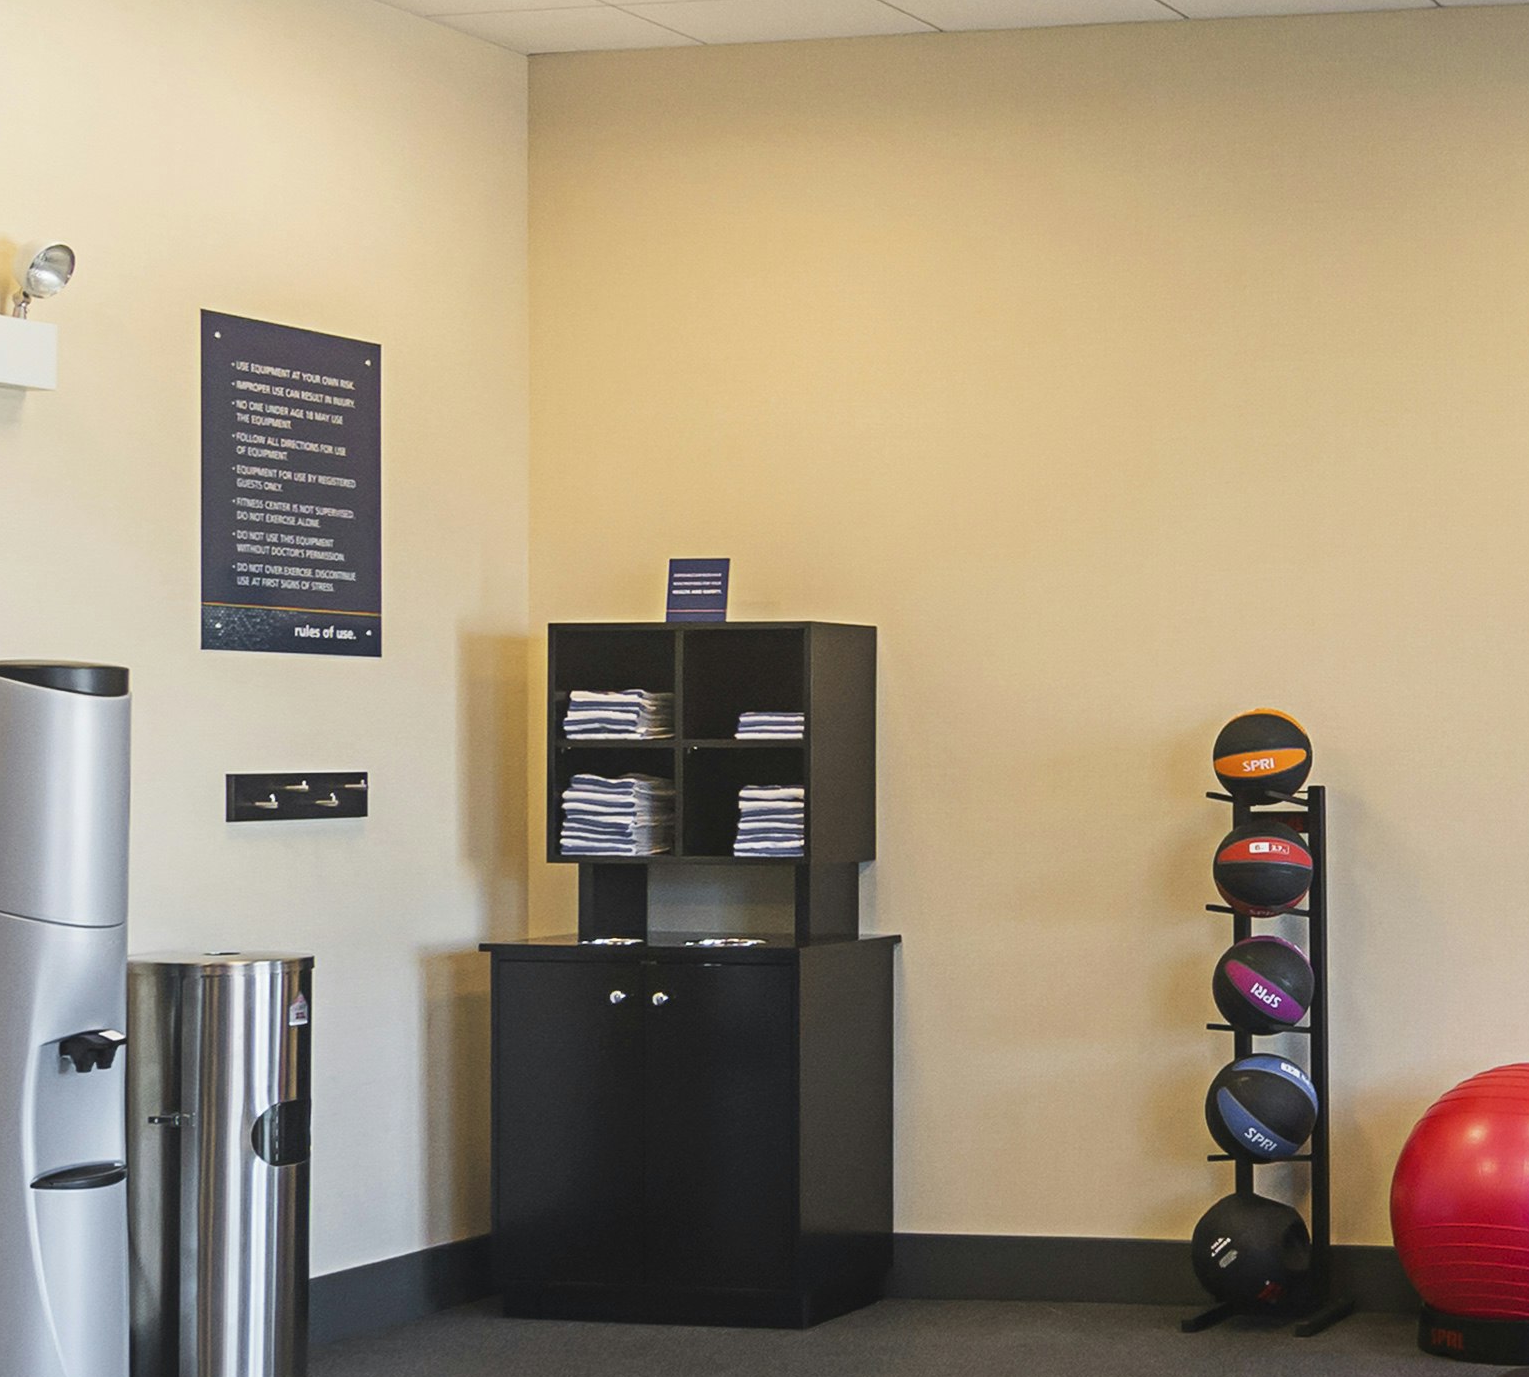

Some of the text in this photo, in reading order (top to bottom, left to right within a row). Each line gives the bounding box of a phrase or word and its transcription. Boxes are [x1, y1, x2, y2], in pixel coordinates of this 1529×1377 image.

[236, 361, 249, 372] USE
[251, 363, 290, 378] EQUIPMENT
[292, 371, 300, 380] AT
[302, 372, 321, 383] YOUR
[322, 376, 338, 387] OWN
[236, 380, 270, 394] IMPROPER
[272, 386, 284, 396] USE
[286, 388, 300, 399] CAN
[301, 390, 323, 403] RESULT
[325, 395, 332, 404] IN
[236, 400, 247, 409] NO
[249, 401, 263, 412] ONE
[265, 403, 288, 416] UNDER
[291, 408, 304, 419] AGE
[315, 411, 330, 422] MAY
[331, 415, 343, 425] USE
[236, 412, 250, 423] THE
[236, 432, 347, 457] FOLLOW ALL DIRECTIONS FOR USE
[236, 445, 246, 455] OF
[236, 464, 277, 478] EQUIPMENT
[279, 470, 292, 480] FOR
[293, 472, 306, 482] USE
[236, 478, 263, 490] GUESTS
[236, 497, 263, 509] FITNESS
[265, 501, 290, 511] CENTER
[292, 503, 299, 512] IS
[300, 504, 314, 514] NOT
[236, 511, 248, 520] DO
[249, 512, 265, 522] NOT
[266, 513, 295, 525] EXERCISE
[236, 530, 334, 547] DO NOT USE THIS EQUIPMENT
[236, 543, 270, 554] WITHOUT
[236, 562, 248, 572] DO
[249, 563, 263, 573] NOT
[236, 576, 249, 586] USE
[251, 577, 261, 587] AT
[261, 577, 279, 588] FIRST
[280, 579, 300, 590] SIGNS
[301, 581, 310, 590] OF
[294, 624, 356, 640] rules of use.
[1243, 757, 1275, 772] SPRI
[1250, 982, 1282, 1008] SPRI
[1244, 1127, 1277, 1152] SPRI
